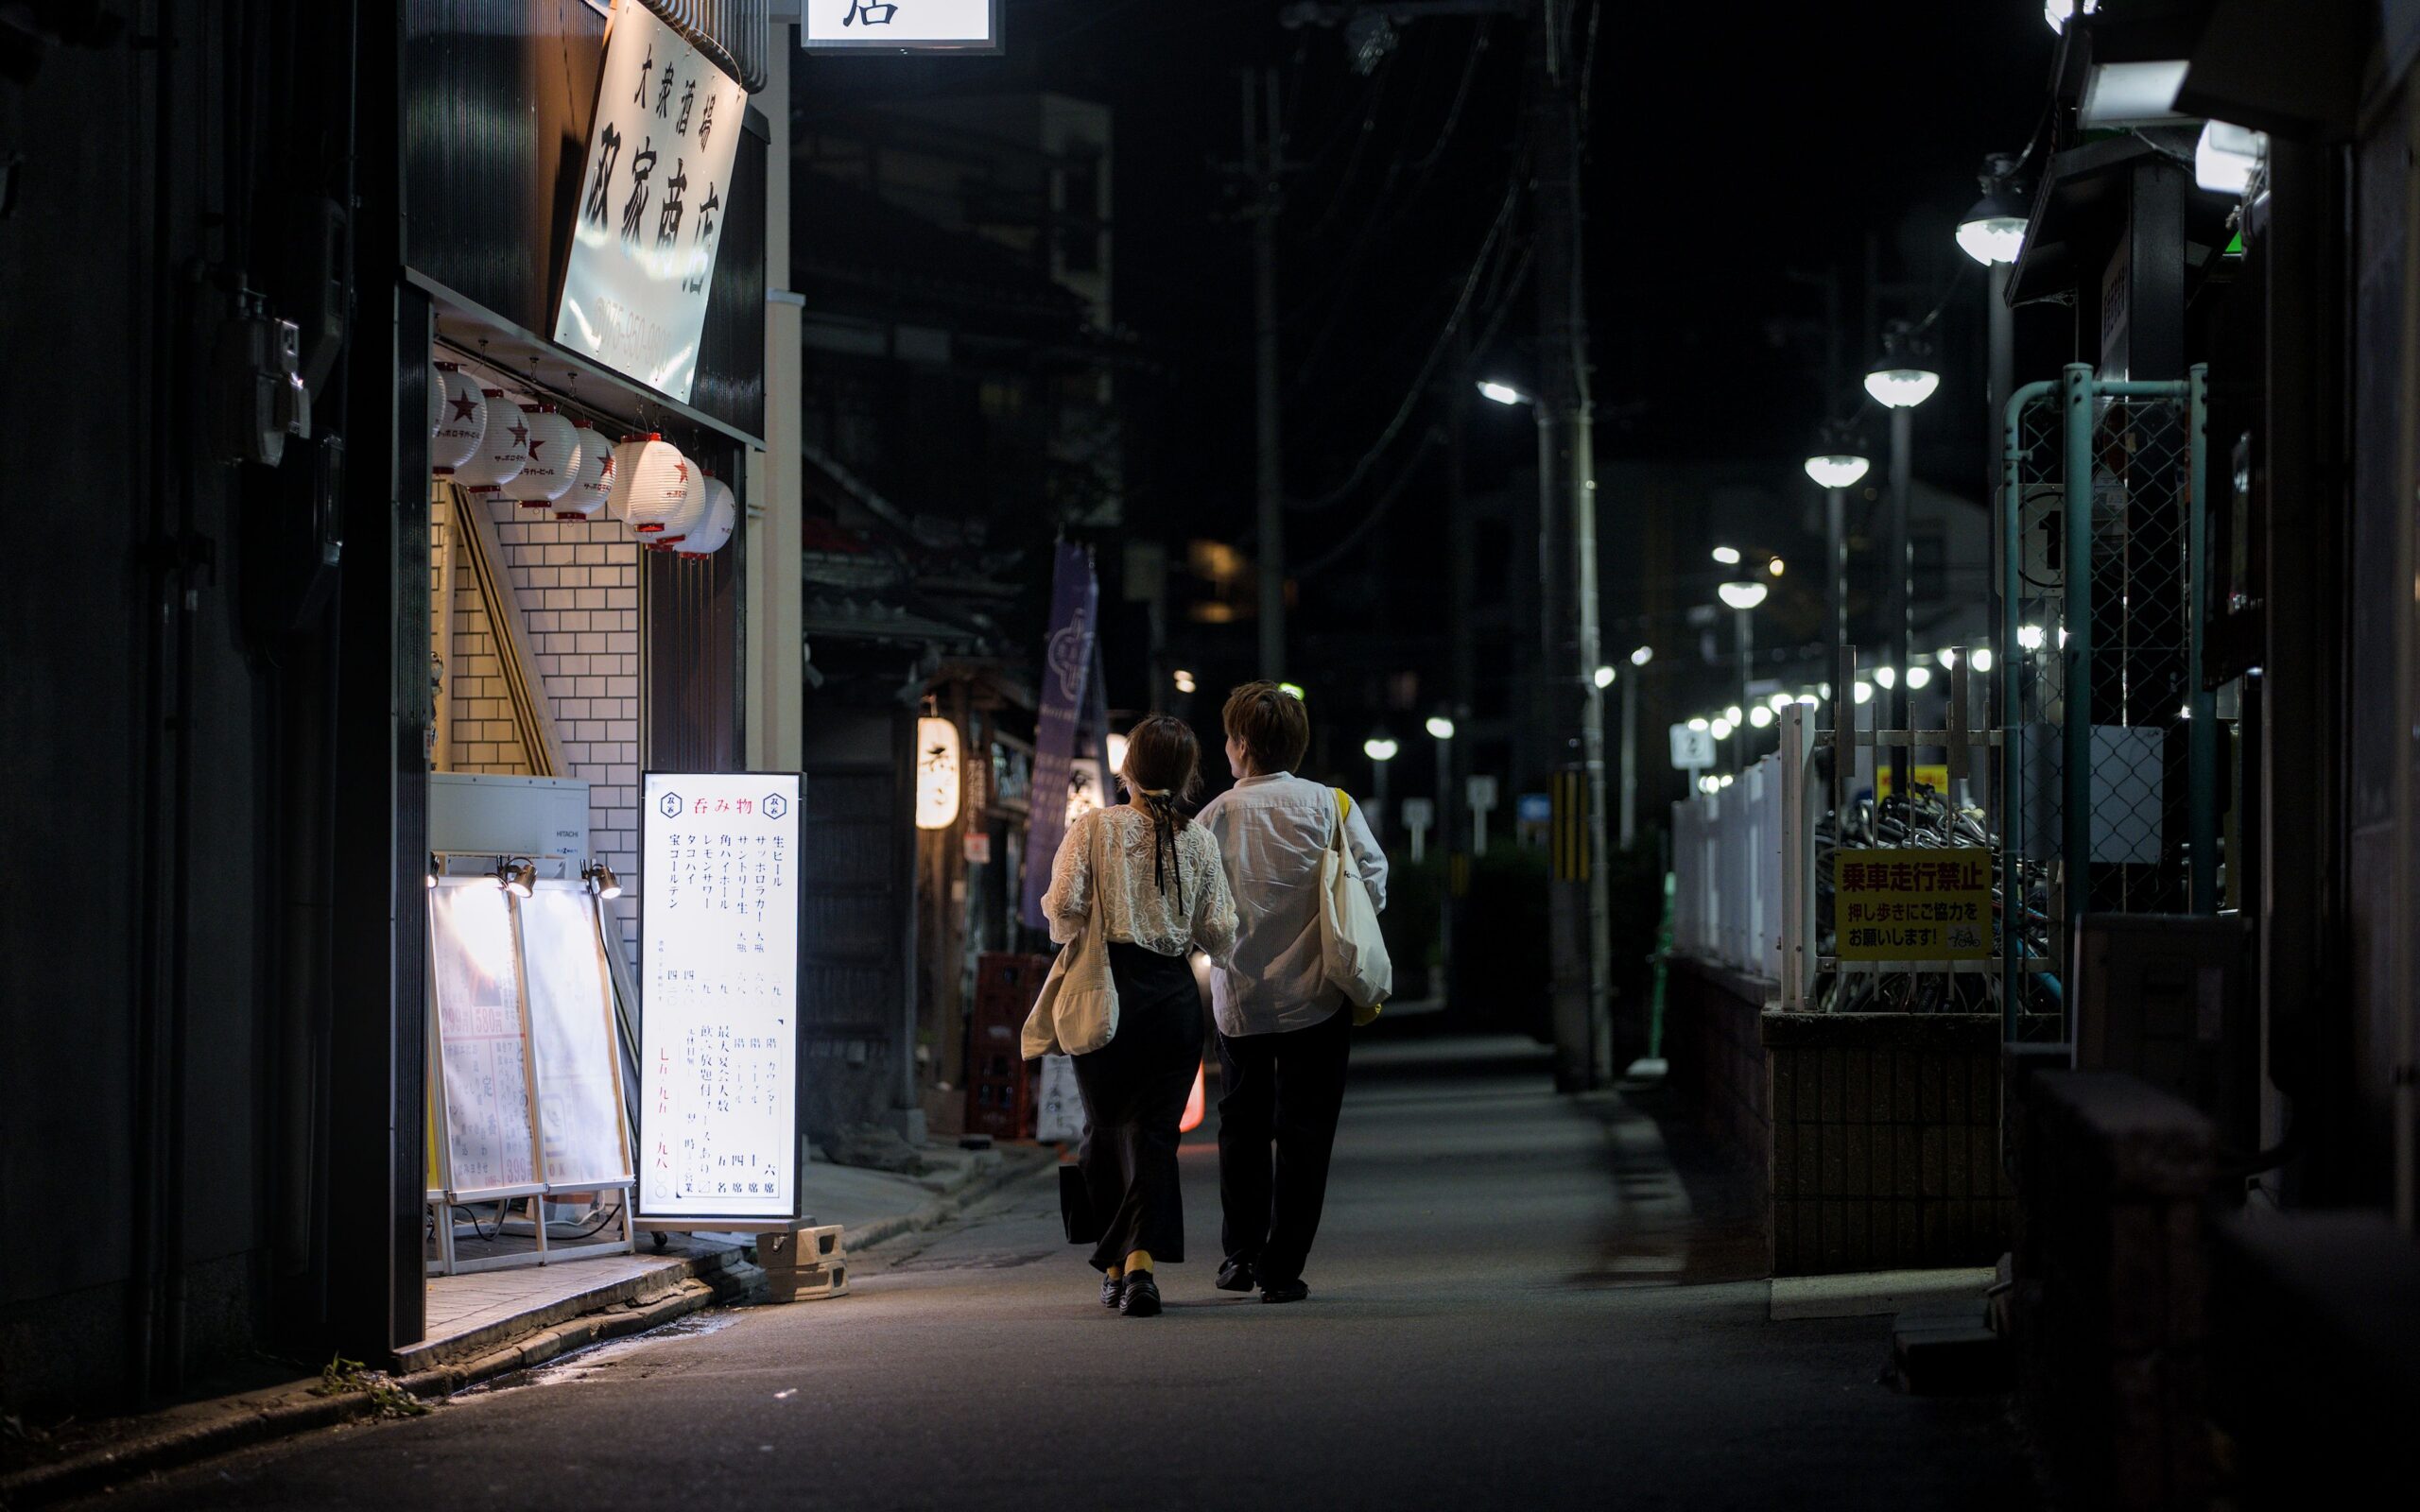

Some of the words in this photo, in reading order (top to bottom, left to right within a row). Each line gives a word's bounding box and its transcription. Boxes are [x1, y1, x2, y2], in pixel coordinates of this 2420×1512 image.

[634, 43, 716, 153] 大衆酒場
[2039, 510, 2061, 570] 1
[694, 798, 752, 815] 呑み物
[686, 834, 696, 885] タコハイ
[702, 834, 713, 909] レモンサワー
[1842, 862, 1984, 892] 乗車走行禁止
[1848, 902, 1978, 922] 押し歩きにご協力を
[482, 1075, 497, 1135] 定番
